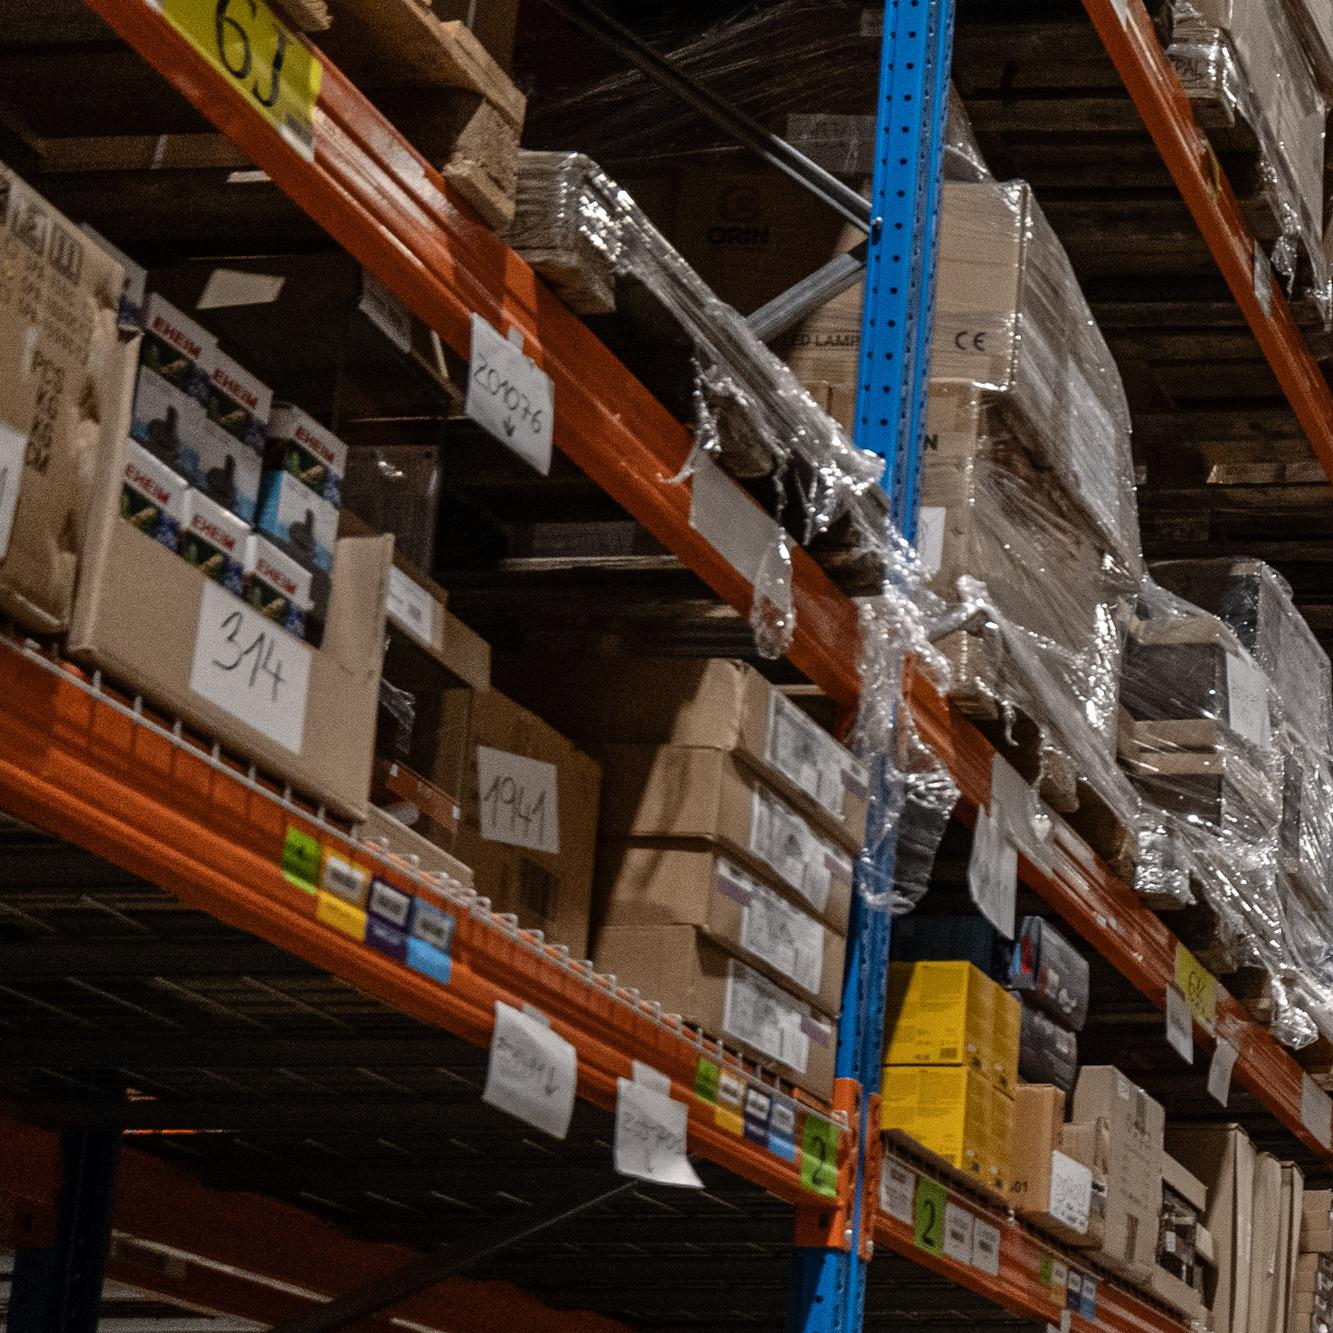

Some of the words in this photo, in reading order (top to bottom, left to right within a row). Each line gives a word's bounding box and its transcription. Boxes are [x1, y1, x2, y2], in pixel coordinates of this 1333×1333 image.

[211, 610, 286, 701] 314
[811, 1135, 827, 1186] 2
[921, 1199, 937, 1247] 2
